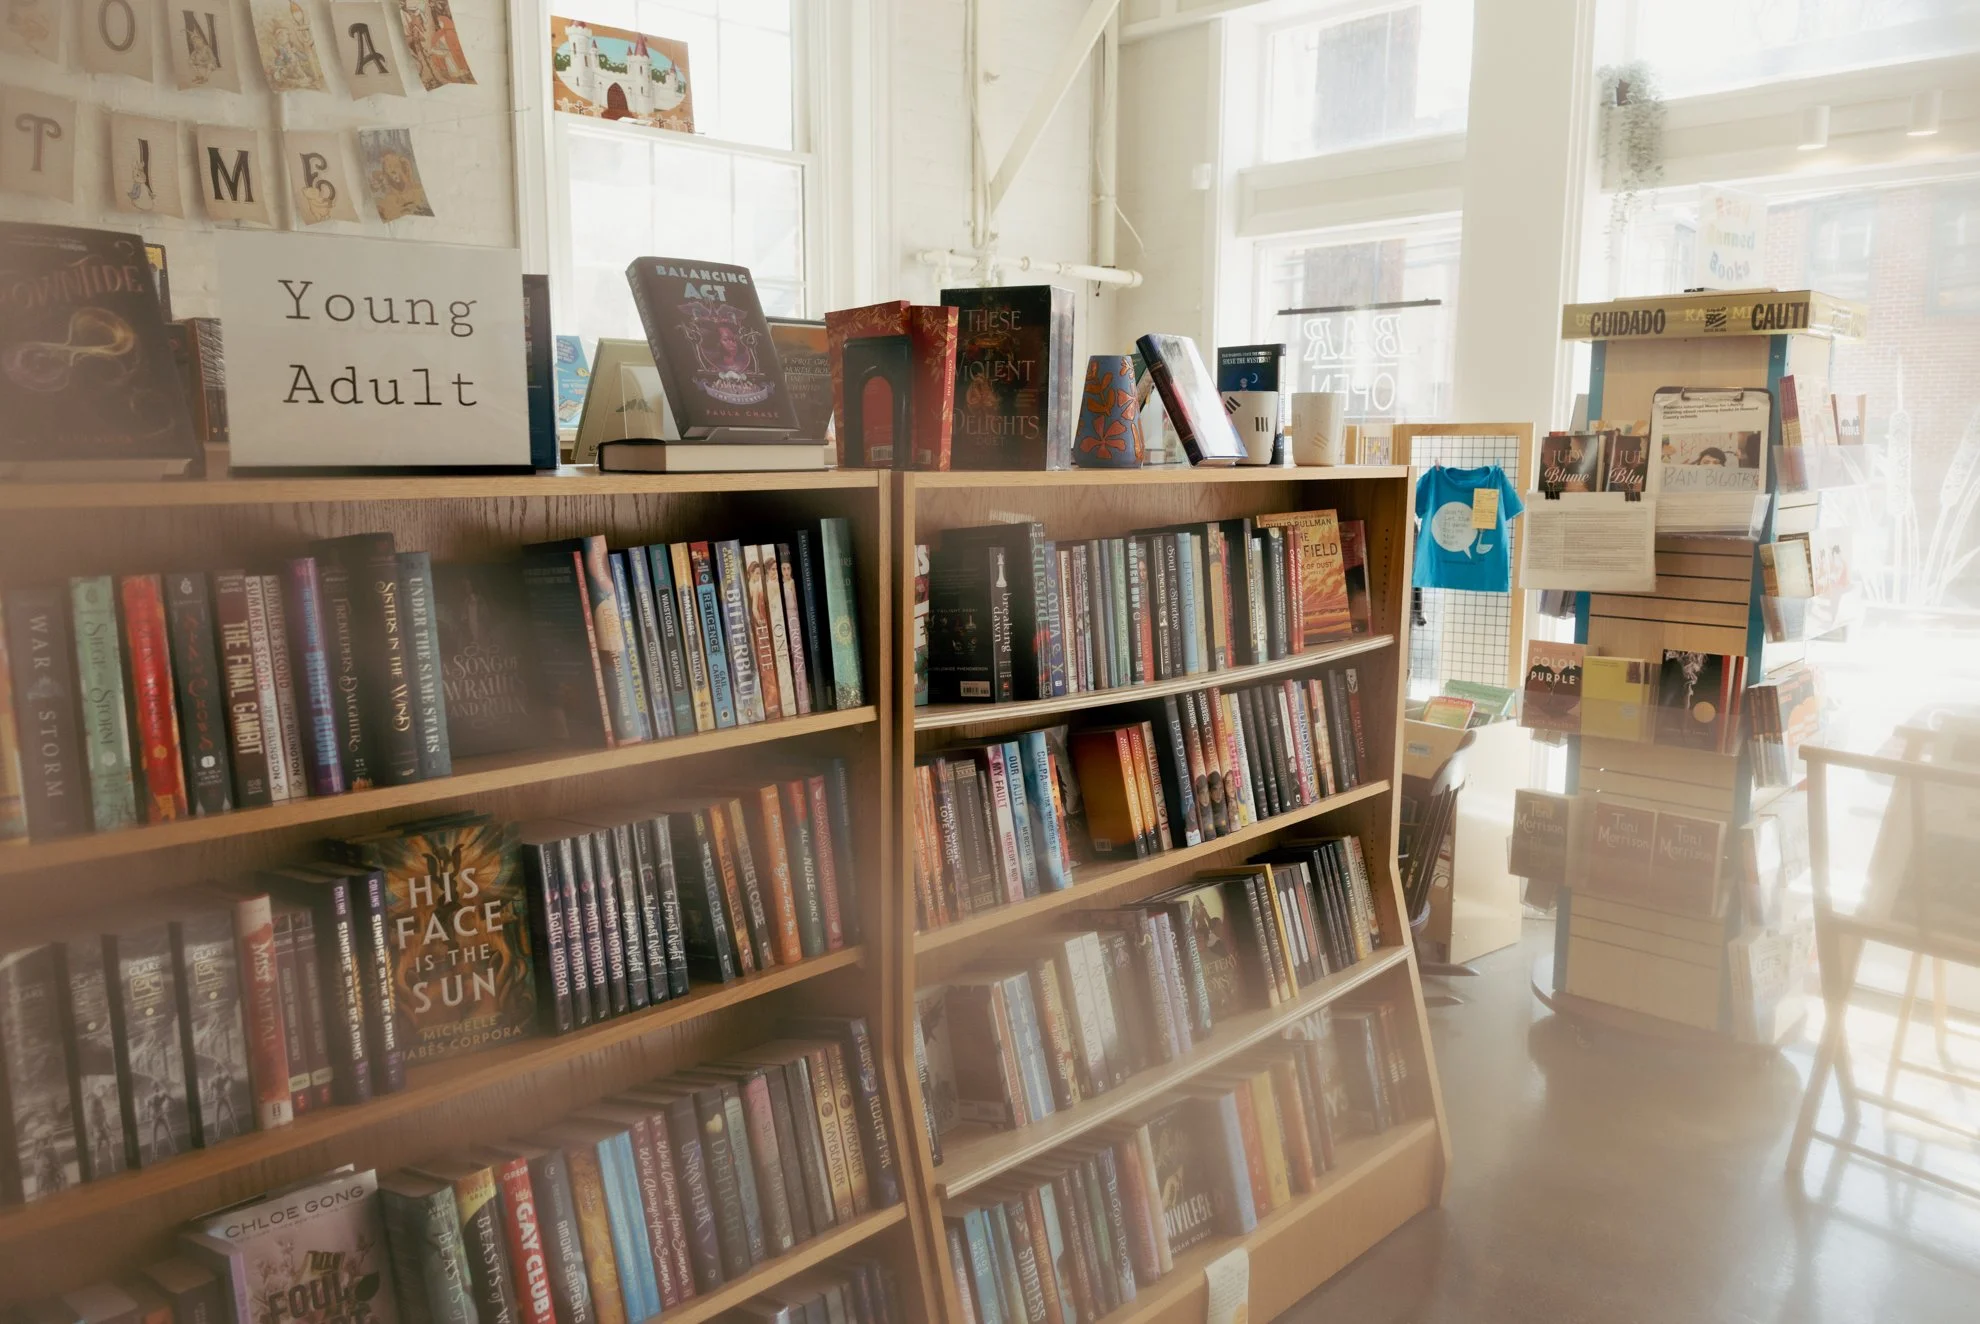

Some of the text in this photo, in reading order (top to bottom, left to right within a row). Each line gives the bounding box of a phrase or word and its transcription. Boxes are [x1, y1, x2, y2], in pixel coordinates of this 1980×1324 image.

[348, 22, 391, 75] A
[15, 112, 335, 204] TIME
[656, 265, 748, 285] BALANCING
[684, 282, 726, 302] ACT
[278, 280, 478, 338] Young
[963, 309, 1022, 333] THESE
[1590, 307, 1666, 337] CUIDADO
[283, 364, 478, 406] Adult
[955, 360, 1035, 382] VIOLENT
[953, 407, 1040, 440] DELIGHTS
[1544, 466, 1590, 483] Blume
[1552, 450, 1587, 464] JUDY
[1664, 467, 1698, 487] BAN
[1295, 518, 1332, 528] PULLMAN
[1128, 542, 1140, 584] SKATER
[1303, 543, 1338, 556] FIELD
[221, 620, 251, 650] THE
[661, 594, 682, 688] WAISTCOATS WEAPONRY
[682, 596, 702, 682] MANNERS MUTINY
[773, 623, 788, 657] ONE
[789, 616, 806, 672] CROWN
[992, 606, 1002, 643] dawn
[1001, 592, 1013, 653] breaking
[272, 645, 289, 689] SECOND
[375, 581, 411, 732] SISTERS IN THE WIND
[409, 577, 440, 753] UNDER THE SAME STARS
[452, 654, 503, 680] SONG
[624, 620, 647, 713] EPIC LOVE STORY
[648, 641, 662, 692] CONSPIRACIES
[703, 594, 727, 703] RETICENCE GAIL CARRIGER
[726, 589, 754, 705] BITTERBLUE
[756, 624, 774, 673] ELITE
[1532, 656, 1576, 670] COLOR
[226, 653, 256, 699] FINAL
[246, 581, 281, 783] SUMMER'S SECOND BILLINGTON
[1531, 671, 1575, 685] PURPLE
[28, 615, 64, 798] WAR STORM
[232, 701, 263, 756] GAMBIT
[305, 650, 337, 765] BRIDGET BLOOM
[339, 676, 363, 752] DAUGHTER
[1172, 720, 1182, 756] BLOOD
[993, 762, 1017, 870] MY FAULT MERCEDES
[1009, 755, 1032, 866] OUR FAULT MERCEDES
[1036, 751, 1056, 845] CULPA MERCEDES
[940, 806, 954, 864] LOVE MAGIC
[1516, 812, 1564, 835] Morrison
[1598, 825, 1649, 849] Morrison
[1612, 812, 1639, 833] Toni
[1675, 824, 1702, 847] Toni
[721, 856, 735, 888] KILL
[1659, 836, 1713, 864] Morrison
[368, 880, 380, 907] COLLINS
[407, 866, 480, 910] HIS
[703, 860, 726, 934] DEATH CURE
[800, 828, 818, 923] ALL NOISE ONCE
[334, 886, 346, 916] COLLINS
[663, 901, 678, 932] Longest
[748, 892, 765, 929] CODE
[337, 922, 351, 971] SUNRISE
[371, 913, 385, 964] SUNRISE
[395, 900, 503, 951] FACE
[644, 906, 664, 967] Longest Night
[668, 935, 683, 961] Night
[1255, 917, 1270, 963] BECOMES
[1265, 912, 1280, 960] BECOMES
[415, 943, 492, 973] IS THE
[628, 946, 643, 973] Night
[1188, 936, 1209, 1010] CELESTIAL MONSTERS
[346, 989, 355, 1004] THE
[380, 980, 388, 996] THE
[412, 967, 497, 1015] SUN
[348, 1007, 363, 1060] REAPING
[381, 999, 395, 1051] REAPING
[423, 1015, 498, 1042] MICHELLE
[450, 1026, 522, 1050] CORPORA
[824, 1121, 845, 1188] RAYBEARER
[844, 1114, 864, 1178] RAYBEARER
[869, 1096, 891, 1169] REDEMPTOR
[225, 1185, 365, 1239] CHLOE GONG
[711, 1137, 740, 1245] DEEPLIGHT
[1107, 1180, 1122, 1226] BLOOD
[648, 1216, 663, 1252] Have
[667, 1208, 682, 1242] Have
[1034, 1231, 1048, 1264] SHARK
[437, 1231, 463, 1306] BEASTS
[476, 1216, 503, 1290] BEASTS
[516, 1204, 552, 1324] GAY CLUB!
[556, 1220, 586, 1323] AMONG SERPENTS
[653, 1246, 673, 1298] Summer
[672, 1236, 690, 1286] Summer
[267, 1274, 351, 1322] FOUL
[1018, 1247, 1046, 1322] STATELESS
